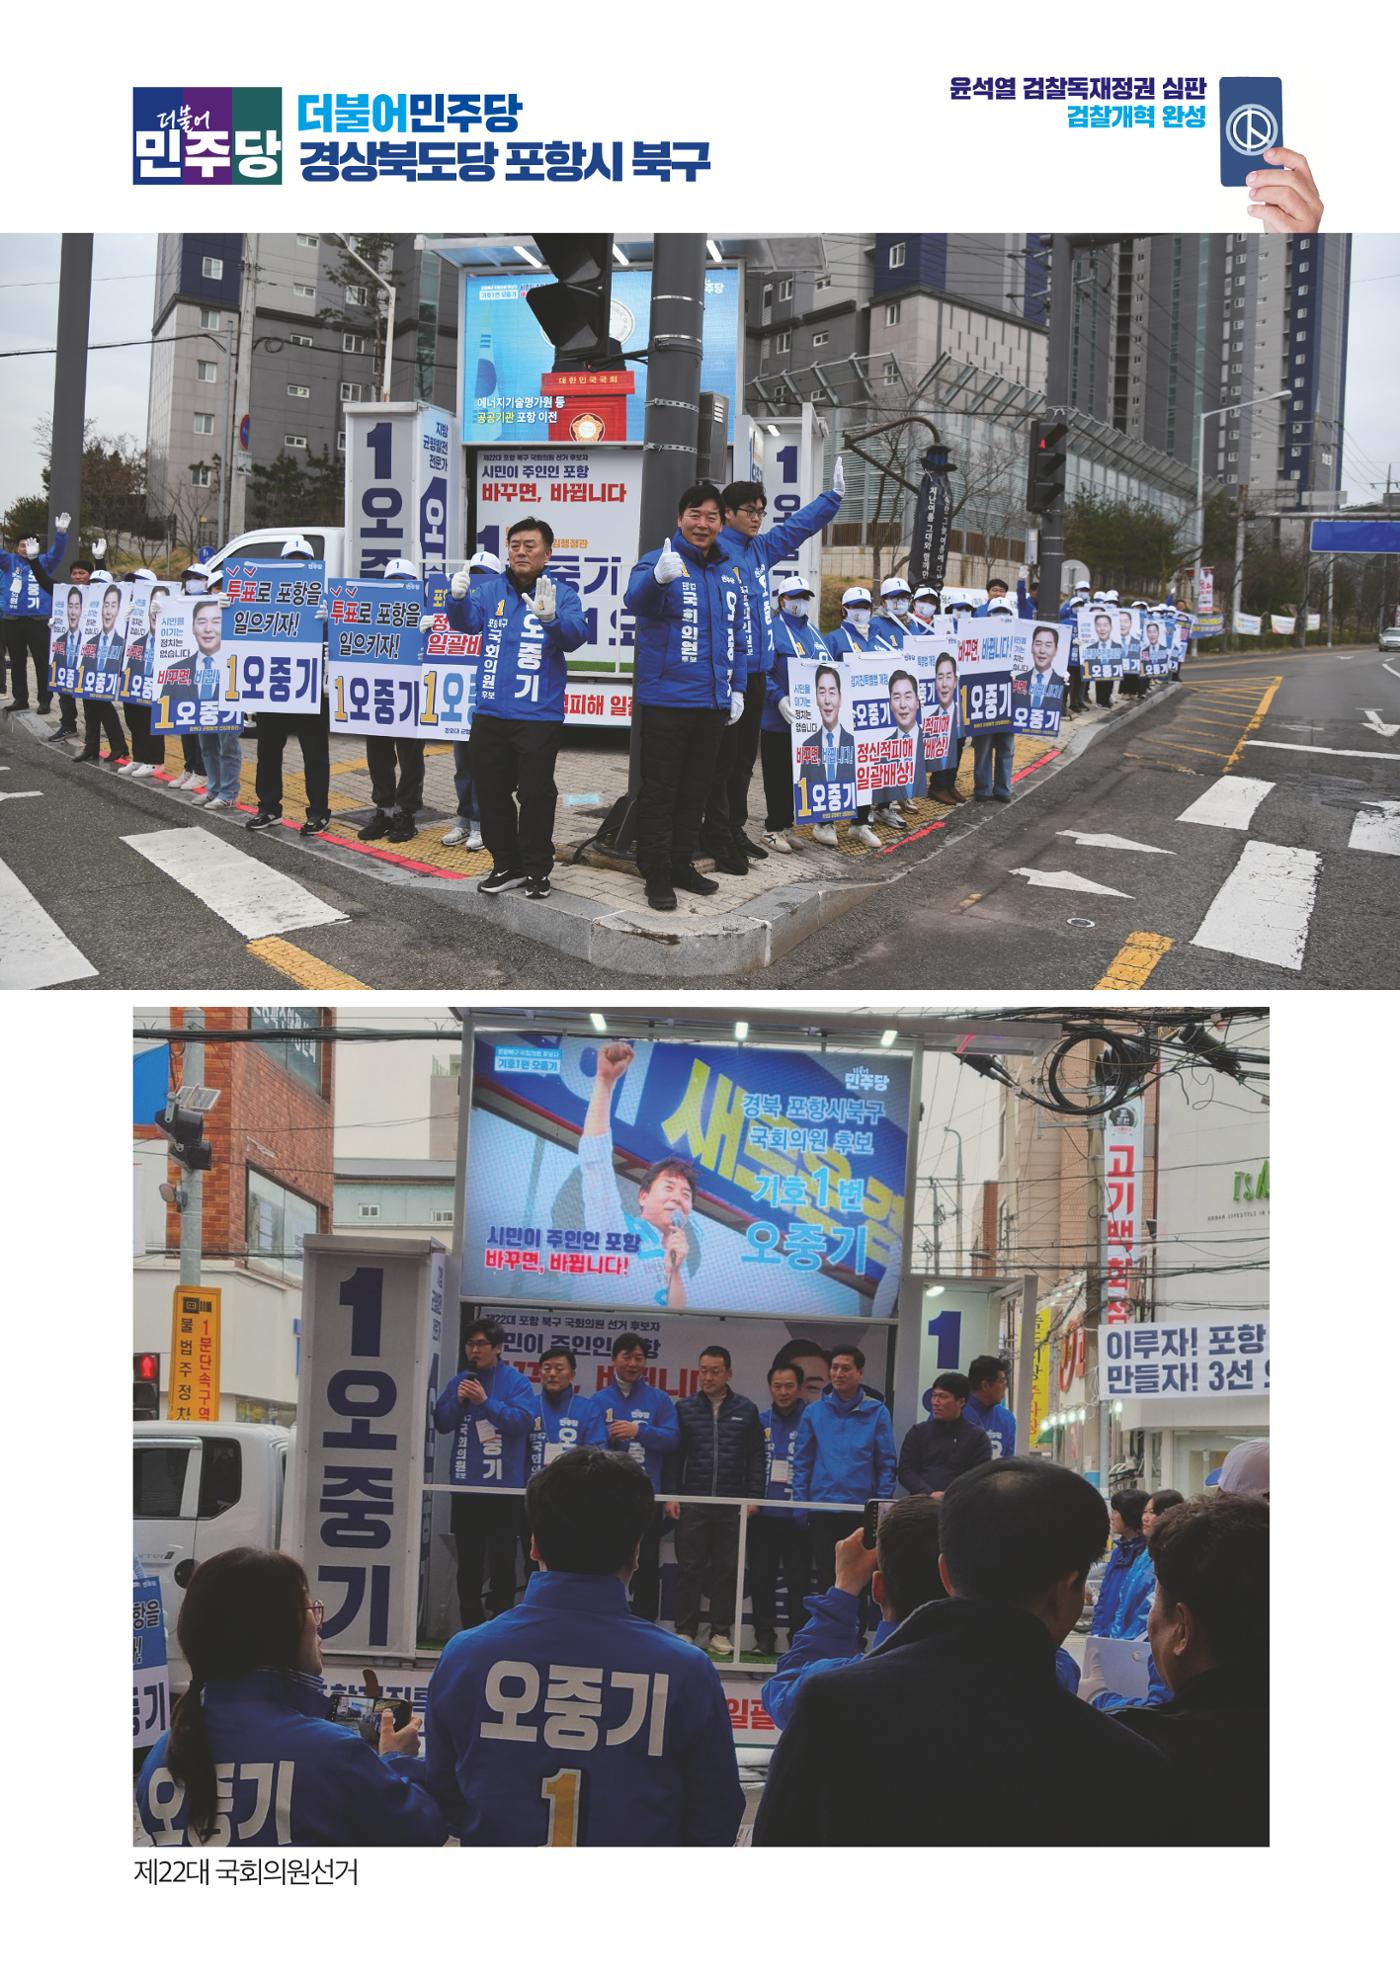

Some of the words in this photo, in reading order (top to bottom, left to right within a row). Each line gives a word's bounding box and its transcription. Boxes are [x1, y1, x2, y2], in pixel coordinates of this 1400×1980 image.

[554, 396, 566, 409] 등
[477, 411, 515, 424] 공공기관
[516, 411, 537, 424] 포항
[537, 411, 558, 424] 이전
[482, 465, 518, 478] 시민이
[522, 465, 560, 478] 주인인
[563, 465, 589, 479] 포항
[482, 483, 542, 502] 바꾸면,
[551, 483, 627, 502] 바뀝니다
[226, 580, 271, 604] 투표로
[276, 582, 322, 607] 포항을
[234, 611, 301, 636] 일으키자!
[330, 601, 371, 626] 투표로
[376, 602, 421, 628] 포항을
[339, 632, 401, 660] 일으키자!
[515, 613, 545, 703] 오중기
[49, 661, 75, 688] 1오중
[120, 667, 154, 699] 1오중
[857, 738, 914, 764] 정신적피해
[857, 763, 914, 791] 일괄배상!
[845, 1072, 890, 1091] 민주당
[742, 1093, 782, 1119] 경북
[788, 1096, 885, 1126] 포항시북구
[751, 1126, 828, 1153] 국회의원
[833, 1131, 875, 1155] 후보
[487, 1226, 541, 1248] 시민이
[546, 1228, 600, 1251] 주인인
[605, 1231, 642, 1253] 포항
[740, 1220, 869, 1276] 오중기
[485, 1249, 545, 1274] 바꾸면,
[549, 1253, 629, 1276] 바뀝니다!
[518, 1315, 540, 1327] 포항
[542, 1316, 562, 1328] 북구
[564, 1317, 605, 1330] 국회의원
[608, 1319, 628, 1332] 선거
[631, 1321, 661, 1332] 후보자
[502, 1332, 544, 1354] 민이
[1107, 1326, 1198, 1360] 이루자!
[1208, 1323, 1266, 1356] 포항
[1107, 1360, 1199, 1395] 만들자!
[1208, 1358, 1253, 1392] 3선
[133, 1599, 160, 1630] 항을
[480, 1660, 670, 1757] 오중기
[541, 1767, 582, 1847] 1
